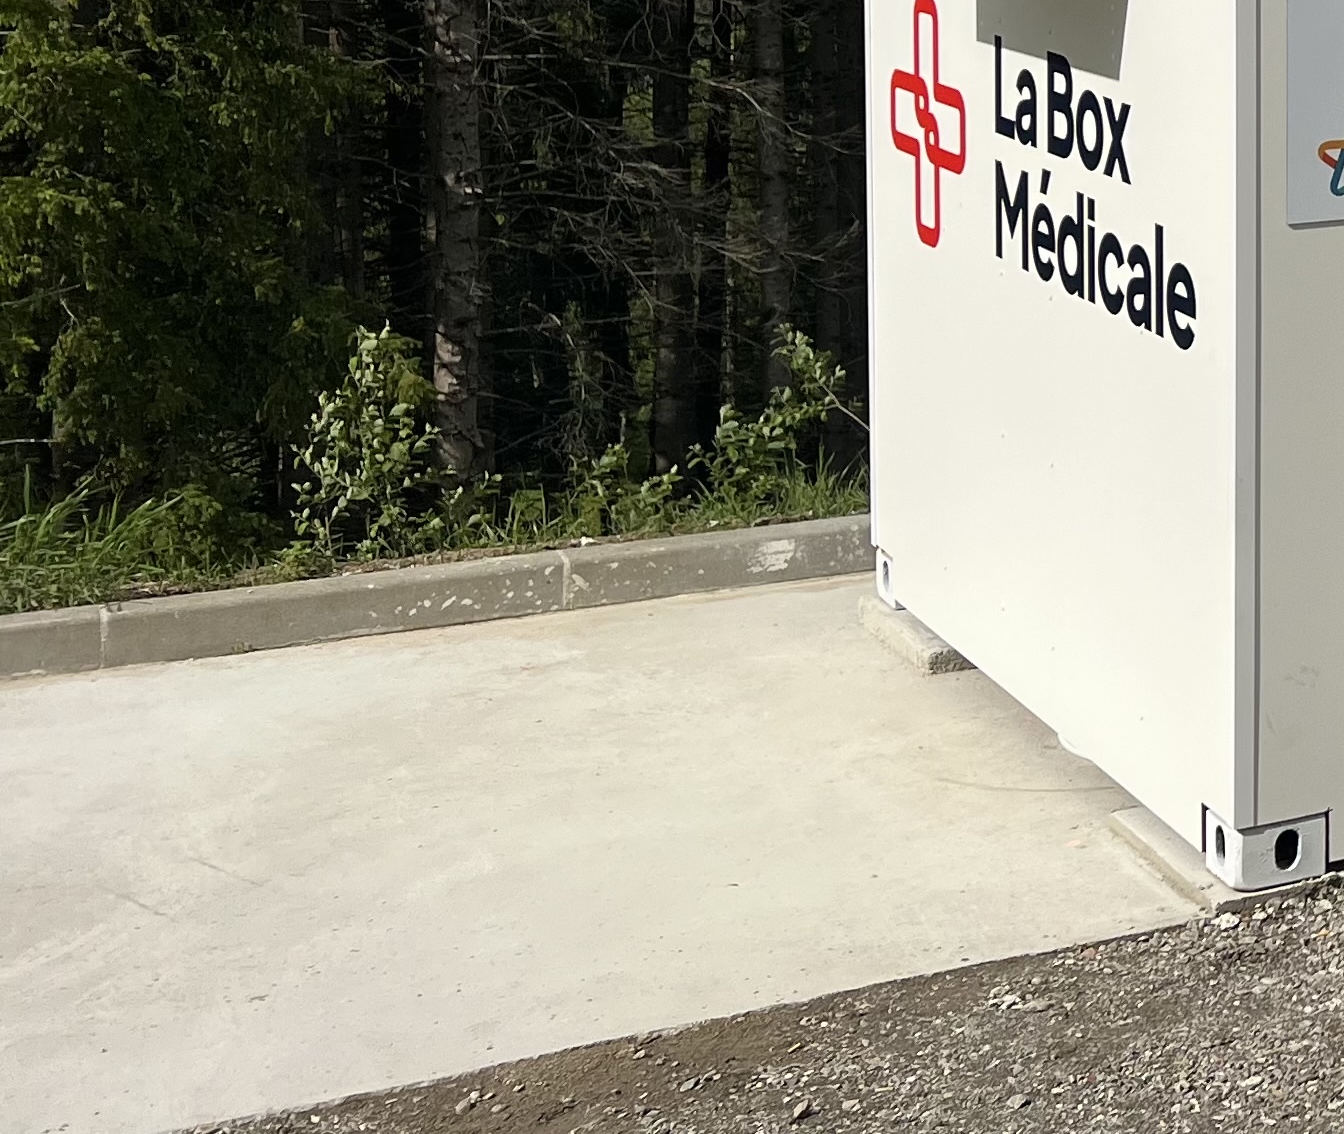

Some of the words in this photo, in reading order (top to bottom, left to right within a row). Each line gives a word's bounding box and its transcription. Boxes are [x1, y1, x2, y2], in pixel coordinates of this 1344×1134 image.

[994, 34, 1038, 148] La
[1046, 50, 1132, 186] Box
[994, 158, 1197, 351] Médicale
